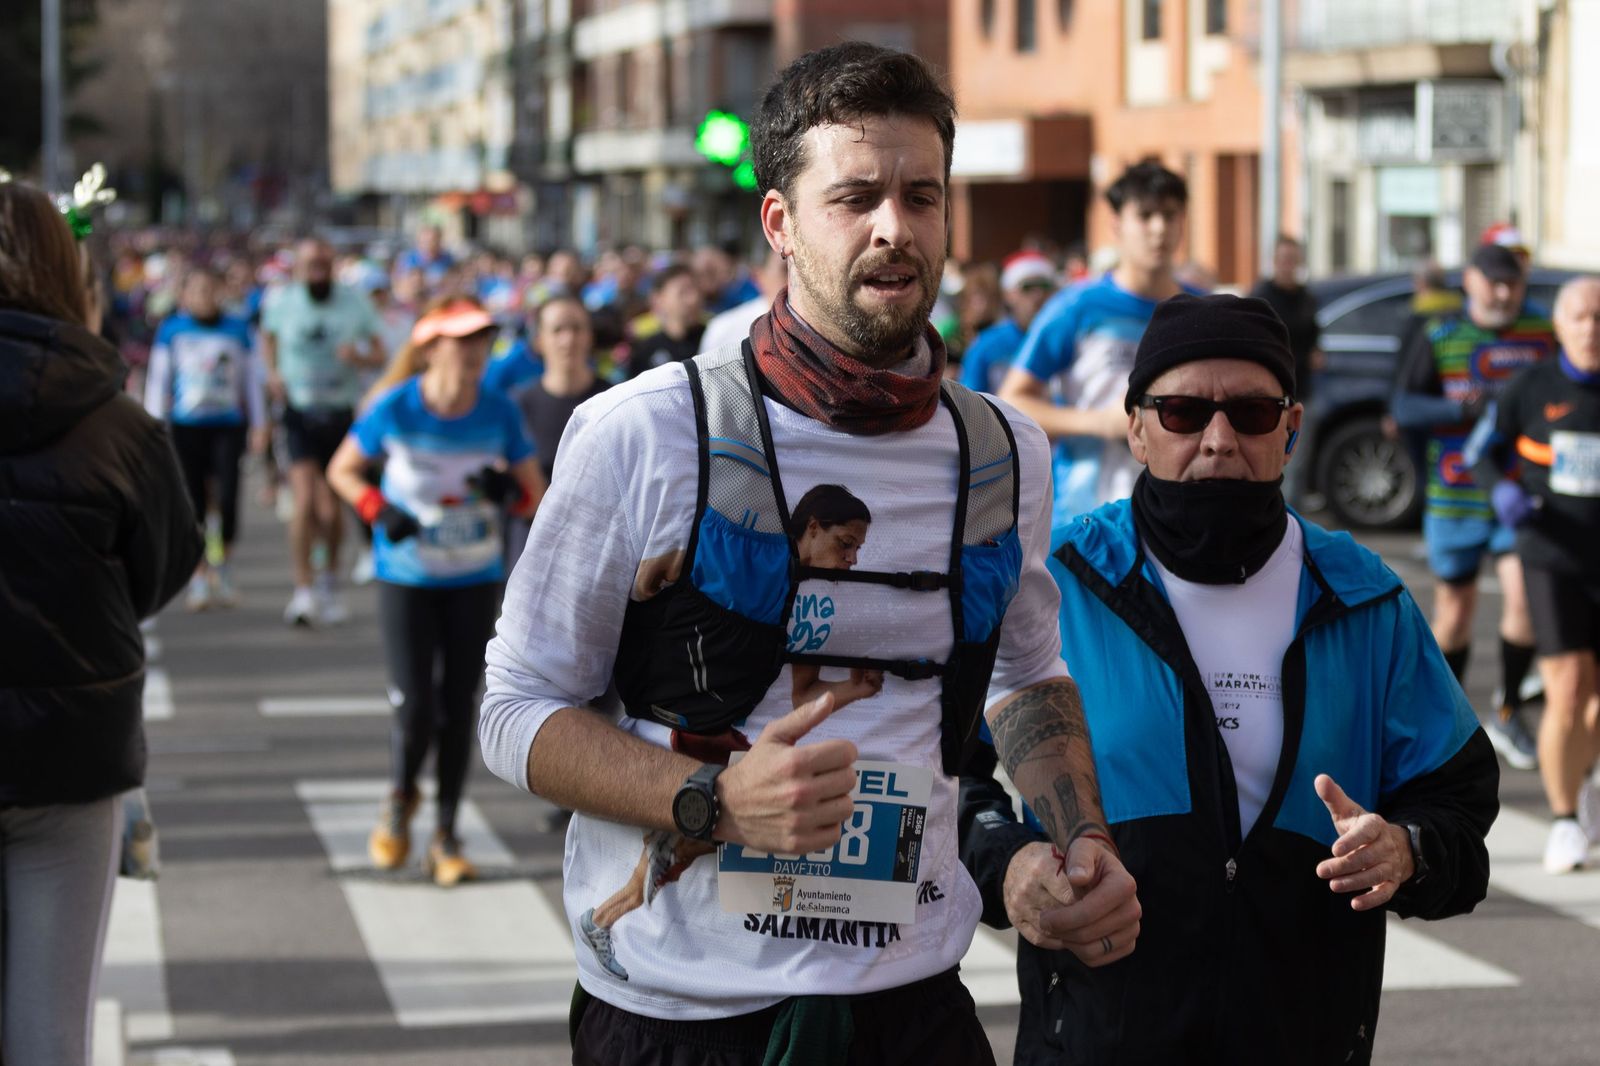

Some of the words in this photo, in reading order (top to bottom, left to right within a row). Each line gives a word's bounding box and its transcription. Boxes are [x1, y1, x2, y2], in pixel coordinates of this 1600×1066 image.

[856, 770, 909, 798] EL
[914, 813, 924, 836] 2568
[796, 889, 852, 902] Ayuntamiento
[796, 902, 806, 911] de
[808, 902, 850, 914] Salamanca
